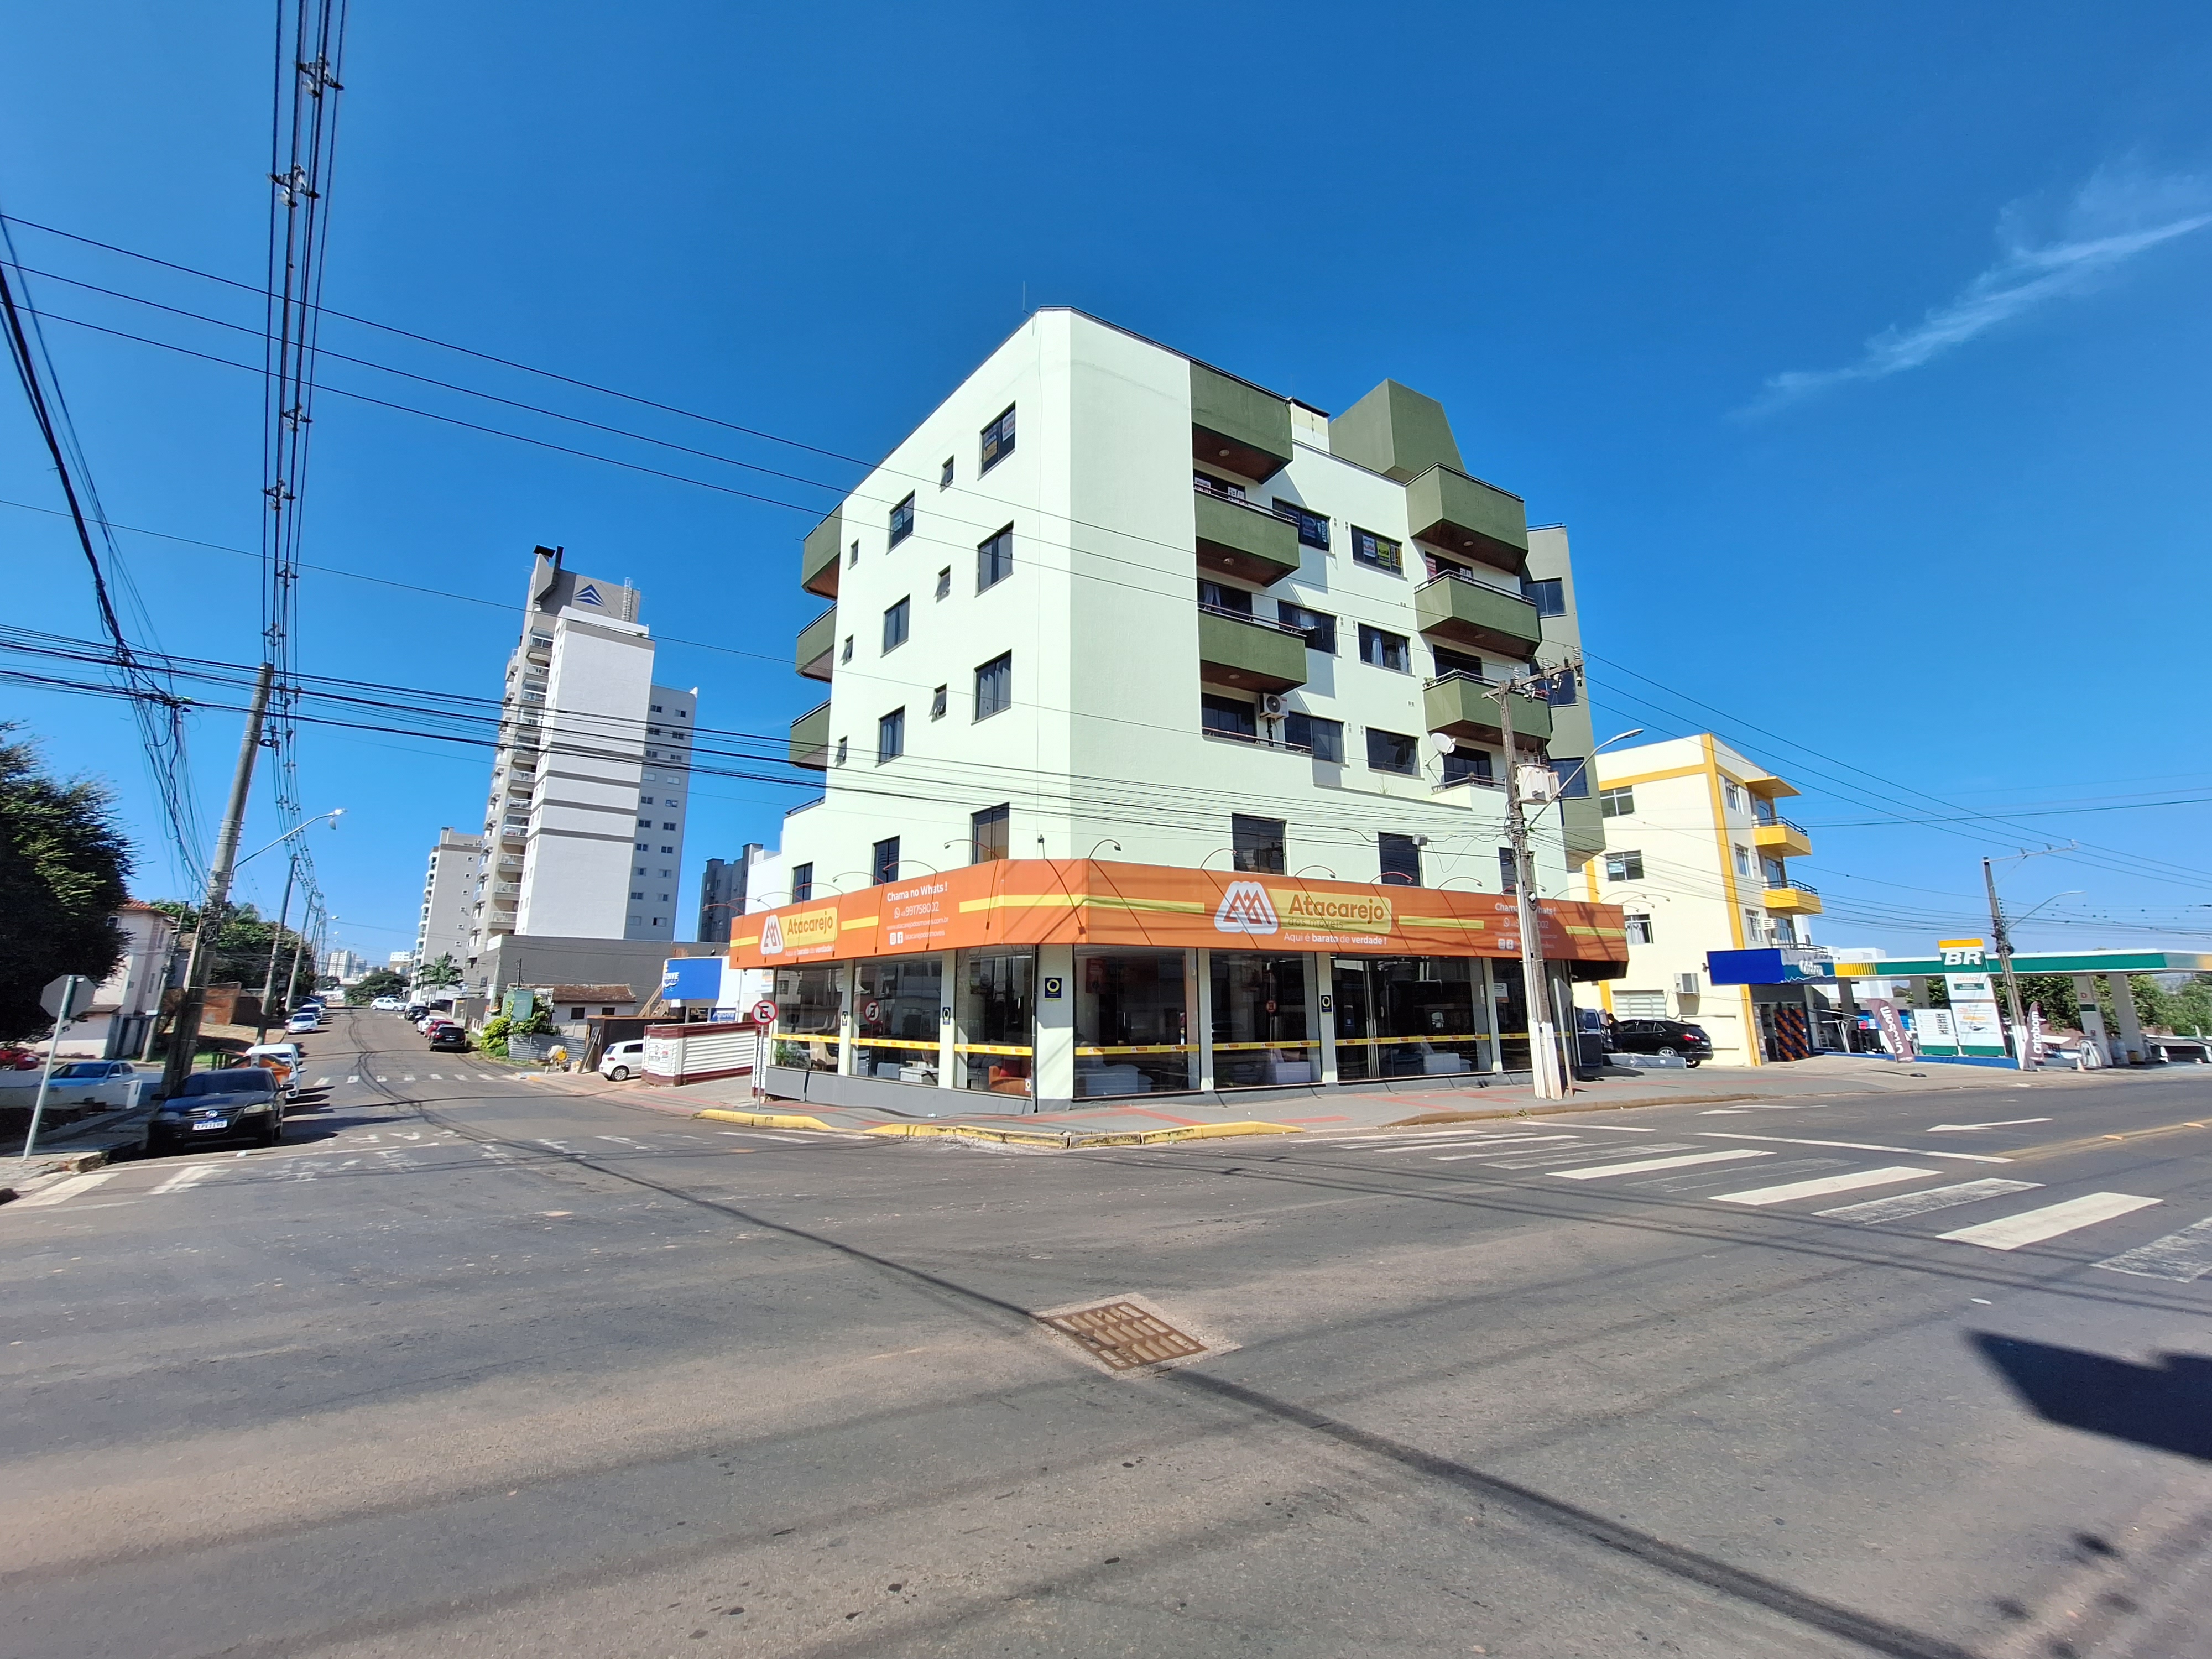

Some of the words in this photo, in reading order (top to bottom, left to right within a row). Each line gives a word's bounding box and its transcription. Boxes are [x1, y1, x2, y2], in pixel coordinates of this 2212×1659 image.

[887, 891, 909, 901] Chama
[910, 889, 919, 898] no
[920, 884, 943, 896] Whats
[1288, 894, 1384, 924] Atacarejo
[787, 911, 833, 936] Atacarejo
[1288, 917, 1306, 926] dos
[1284, 932, 1303, 942] Aqui
[1305, 933, 1310, 942] é
[1312, 934, 1338, 943] barato
[1340, 935, 1350, 943] de
[1352, 936, 1383, 945] verdade
[1944, 951, 1982, 966] BR
[760, 1005, 769, 1019] E
